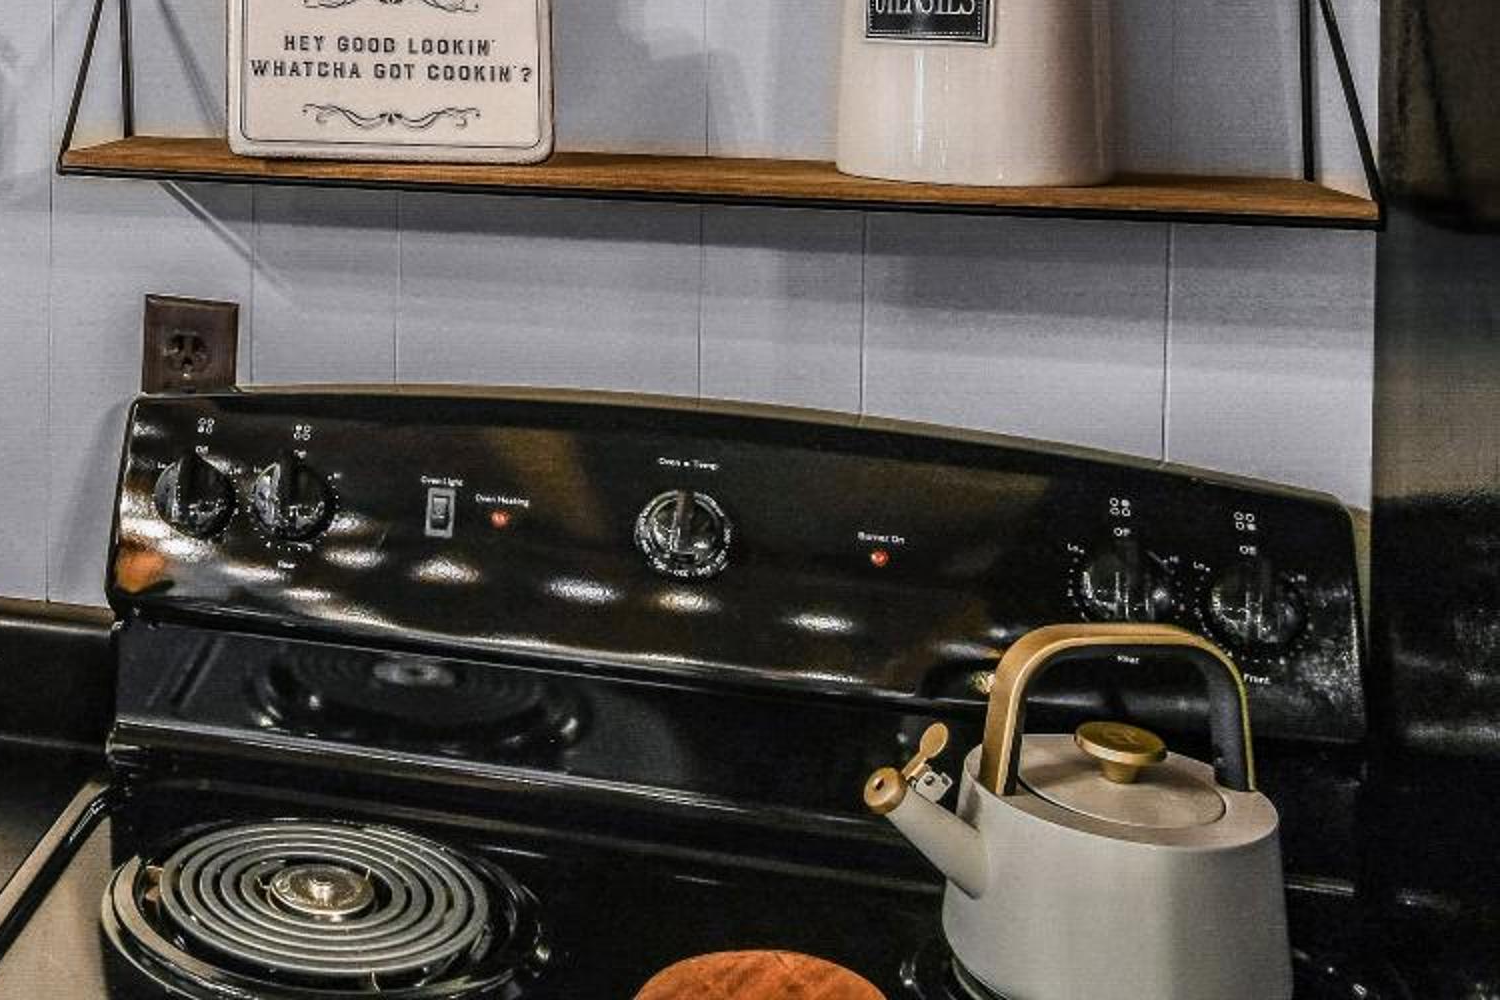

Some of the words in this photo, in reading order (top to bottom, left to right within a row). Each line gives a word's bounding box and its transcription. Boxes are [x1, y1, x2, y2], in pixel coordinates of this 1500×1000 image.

[284, 35, 326, 52] HEY
[337, 36, 396, 54] GOOD
[250, 59, 363, 79] WHATCHA
[373, 63, 416, 79] GOT
